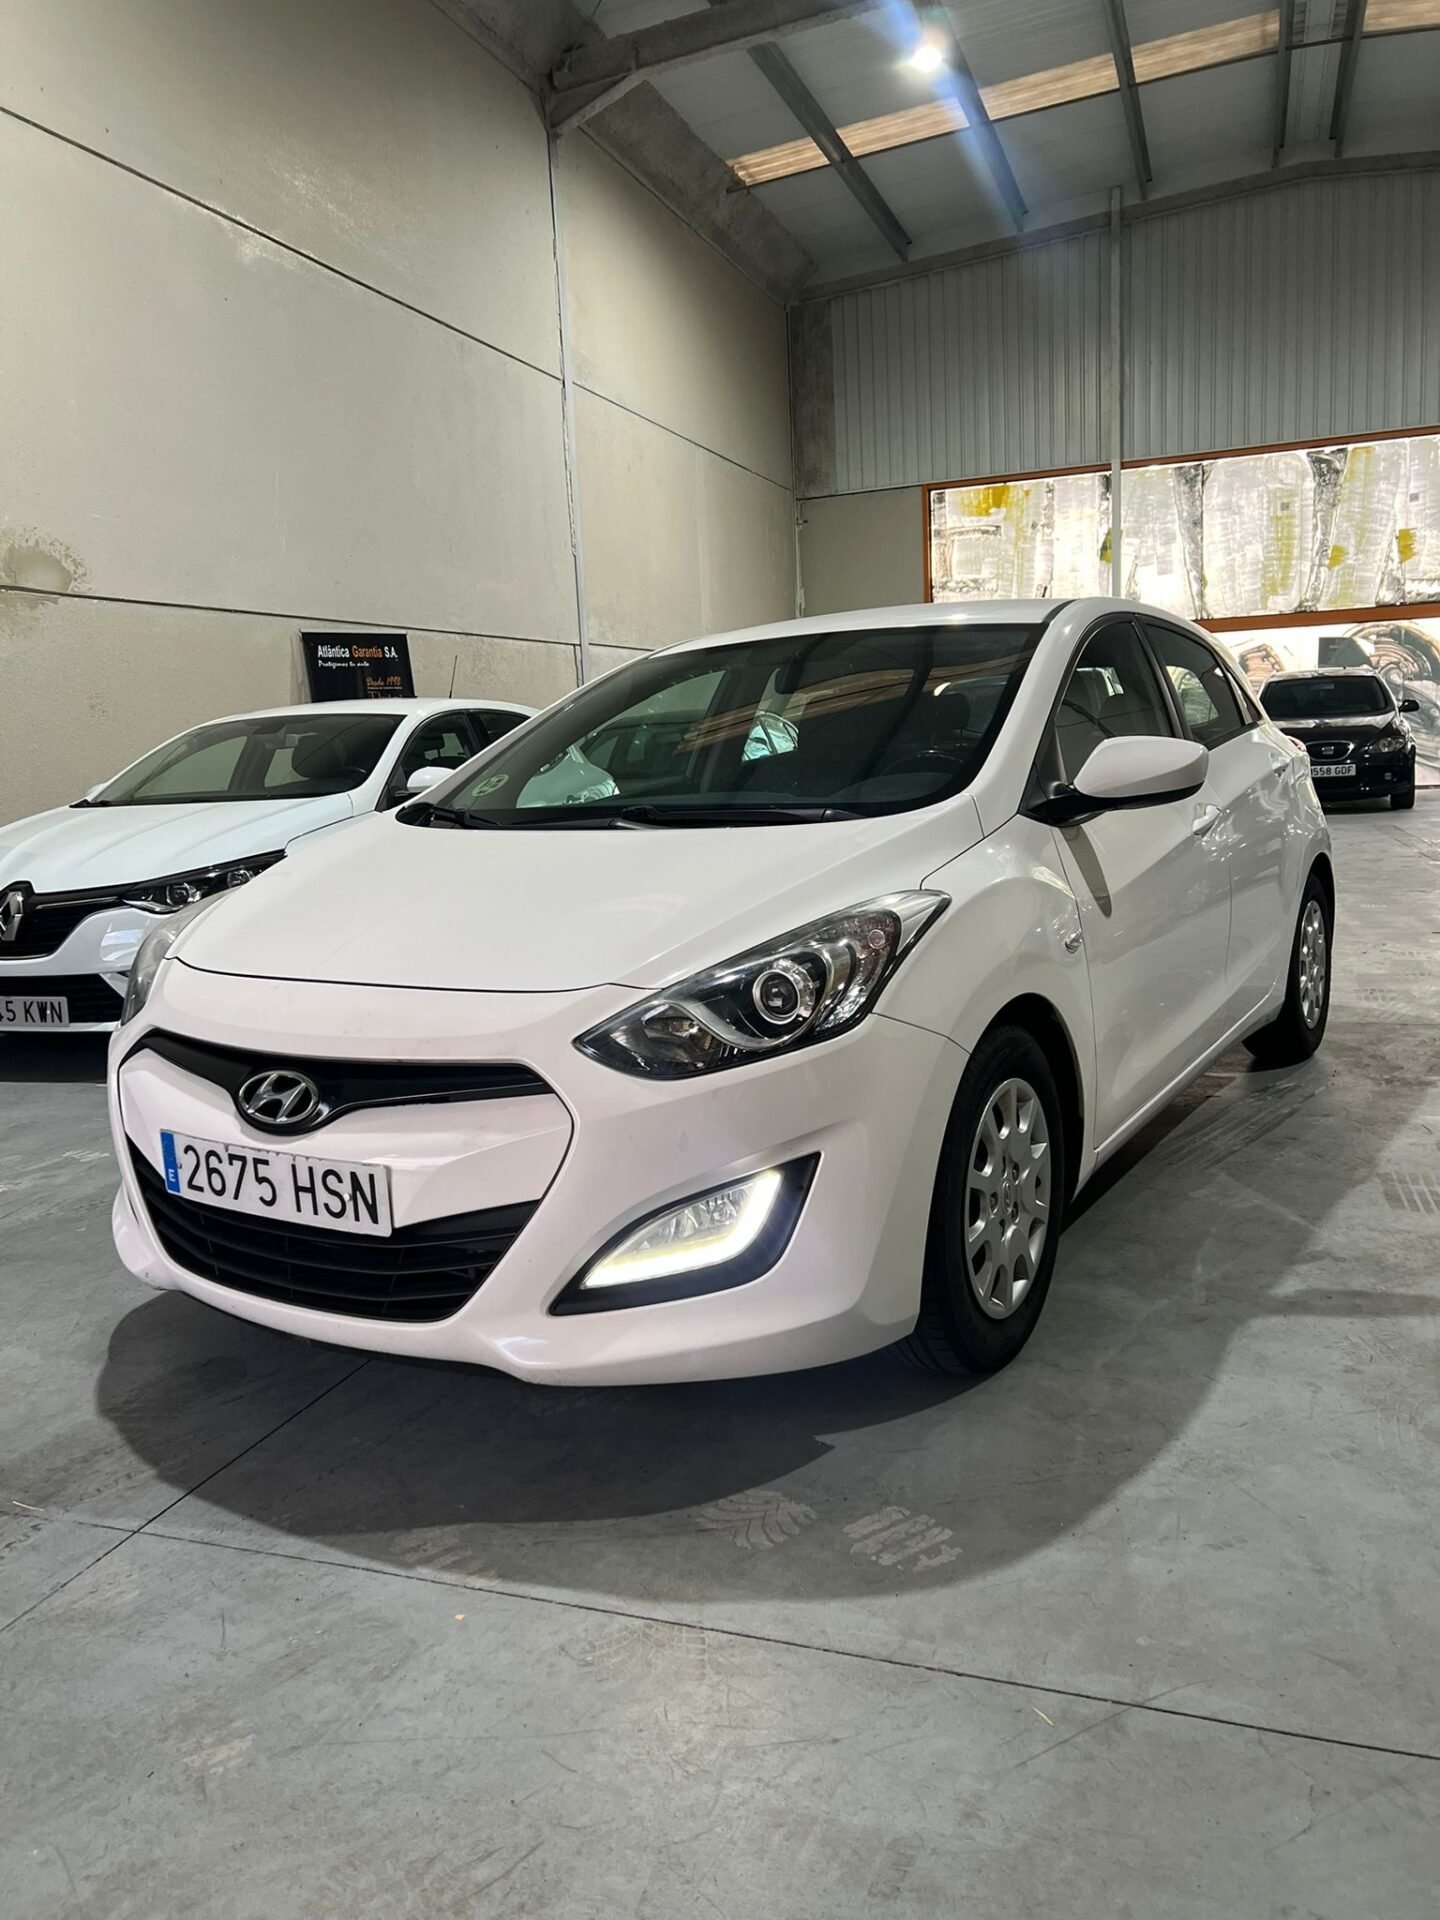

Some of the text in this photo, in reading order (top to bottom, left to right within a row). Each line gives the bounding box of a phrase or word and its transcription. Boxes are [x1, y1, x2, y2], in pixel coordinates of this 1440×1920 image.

[318, 645, 350, 658] Atlántica
[23, 1001, 63, 1023] KWN
[168, 1169, 175, 1182] E
[184, 1144, 379, 1225] 2675 HSN
